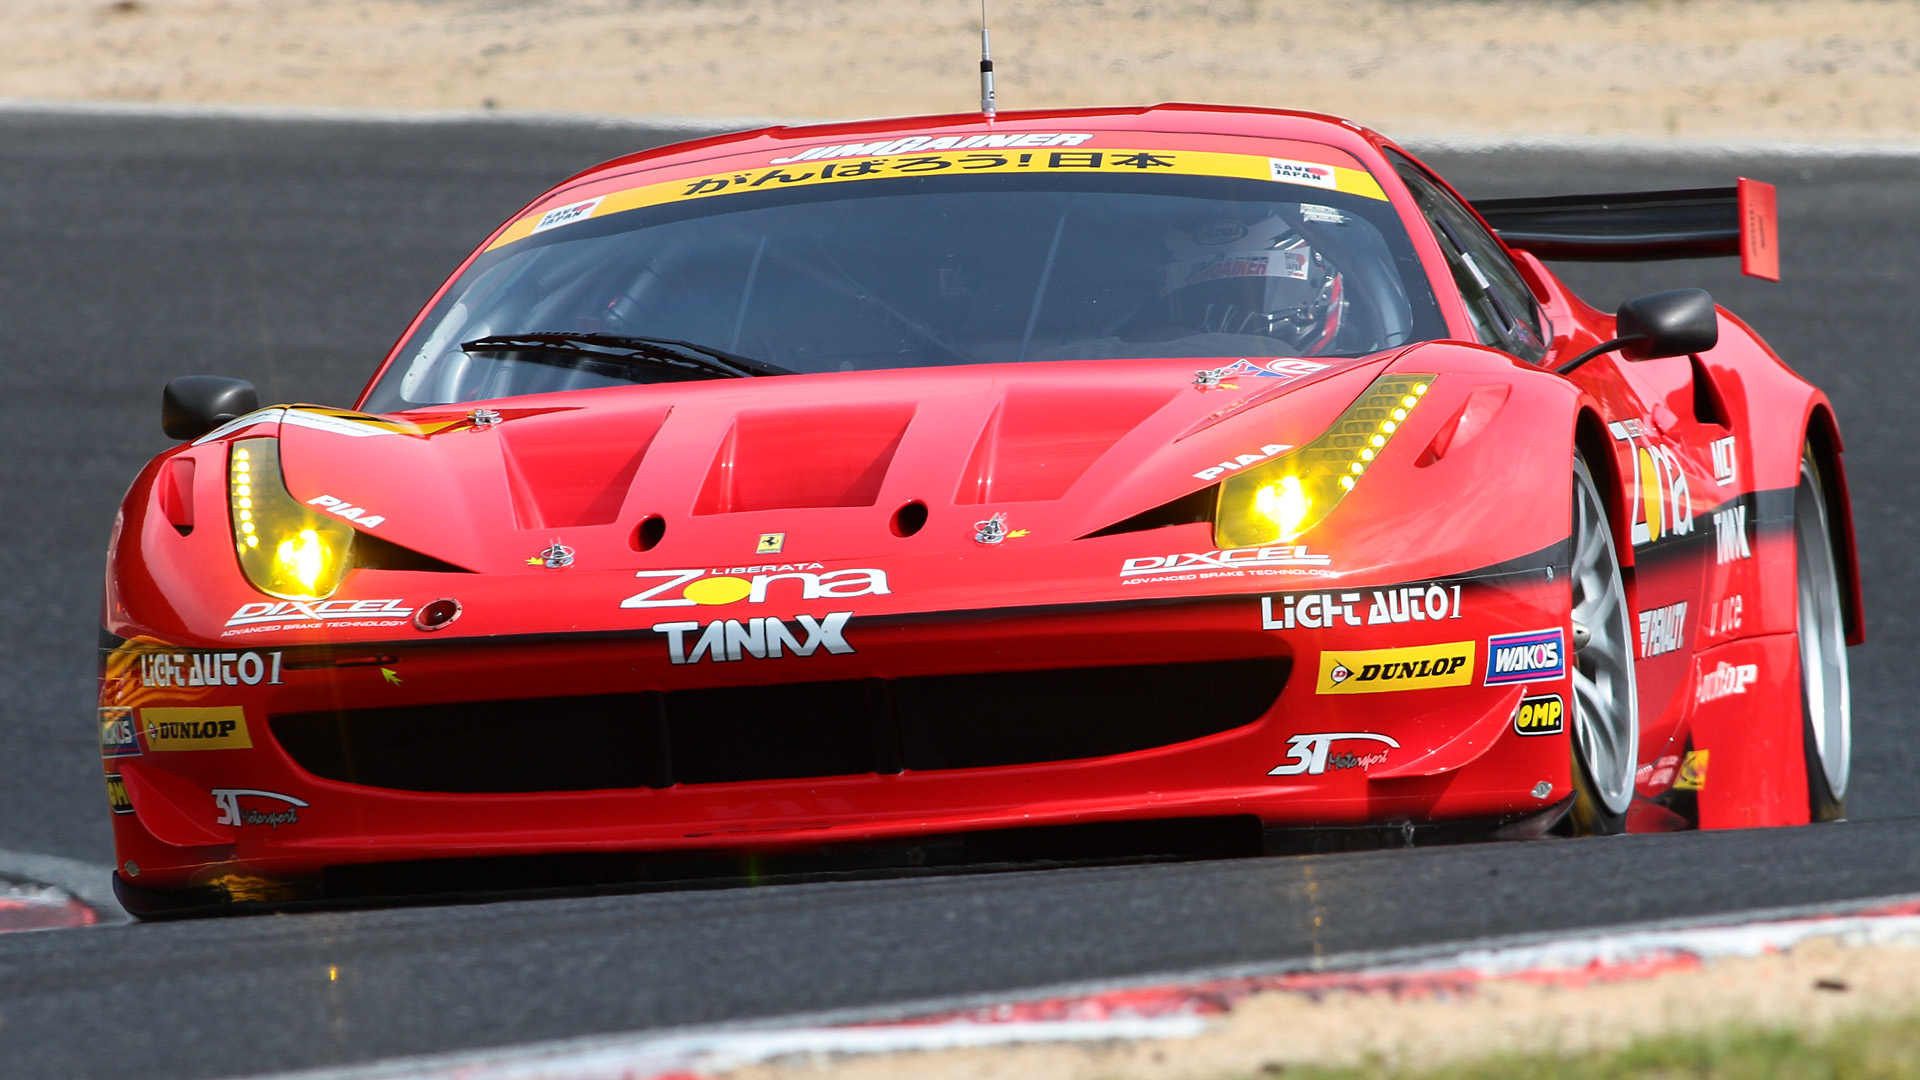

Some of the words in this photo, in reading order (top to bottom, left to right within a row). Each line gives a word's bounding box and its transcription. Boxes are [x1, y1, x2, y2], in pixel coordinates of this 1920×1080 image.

[1275, 169, 1321, 181] JAPAN
[538, 209, 583, 228] JAPAN
[1192, 444, 1294, 480] PIAA
[307, 494, 386, 529] PIAA
[711, 562, 824, 575] LIBERATA
[1120, 545, 1331, 575] DIXCEL
[1121, 573, 1197, 585] ADVANCED
[1199, 570, 1245, 579] BRAKE
[1247, 568, 1338, 578] TECHNOLOGY
[228, 599, 414, 625] DIXCEL
[220, 624, 281, 637] ADVANCED
[282, 622, 322, 631] BRAKE
[326, 620, 407, 628] TECHNOLOGY
[652, 611, 857, 665] TANAX
[1355, 656, 1466, 681] DUNLOP
[1517, 701, 1561, 729] OMP
[160, 720, 236, 739] DUNLOP
